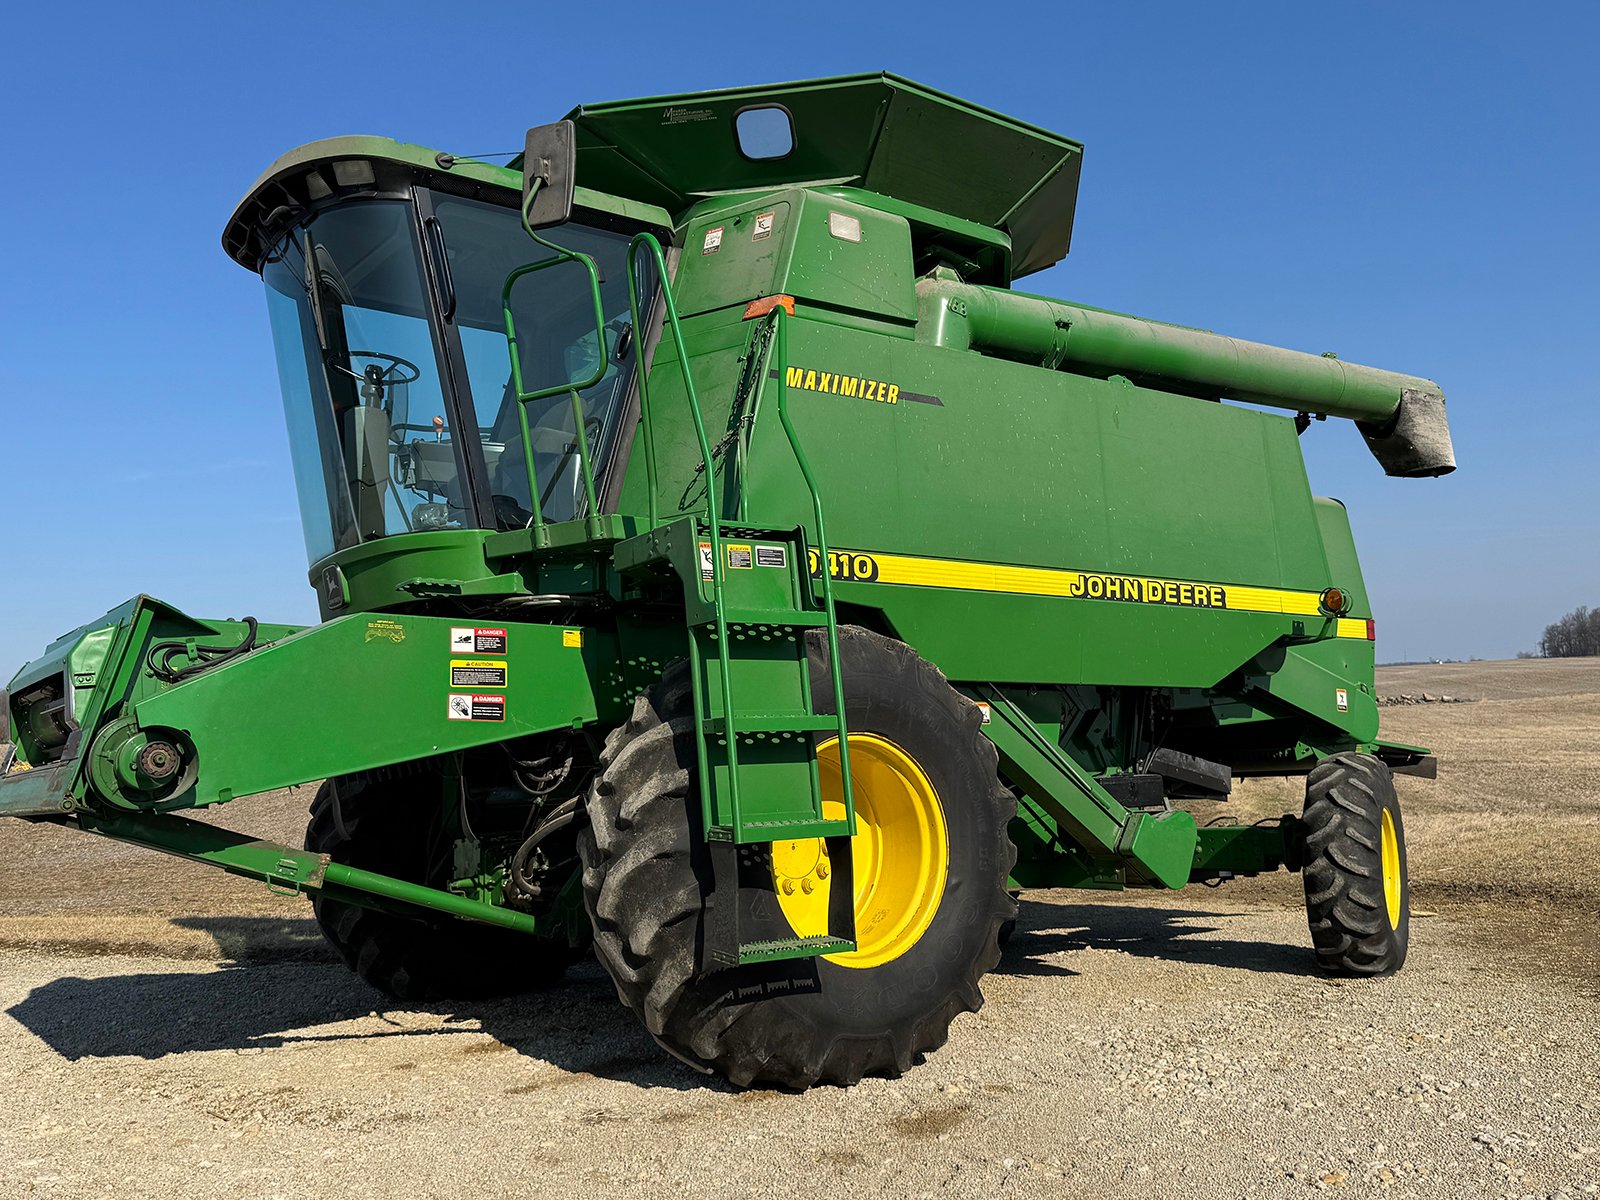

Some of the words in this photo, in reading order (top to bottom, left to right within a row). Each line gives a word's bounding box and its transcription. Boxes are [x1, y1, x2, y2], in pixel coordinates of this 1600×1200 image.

[786, 366, 900, 404] MAXIMIZER
[1070, 574, 1141, 601] JOHN
[1147, 580, 1225, 608] DEERE
